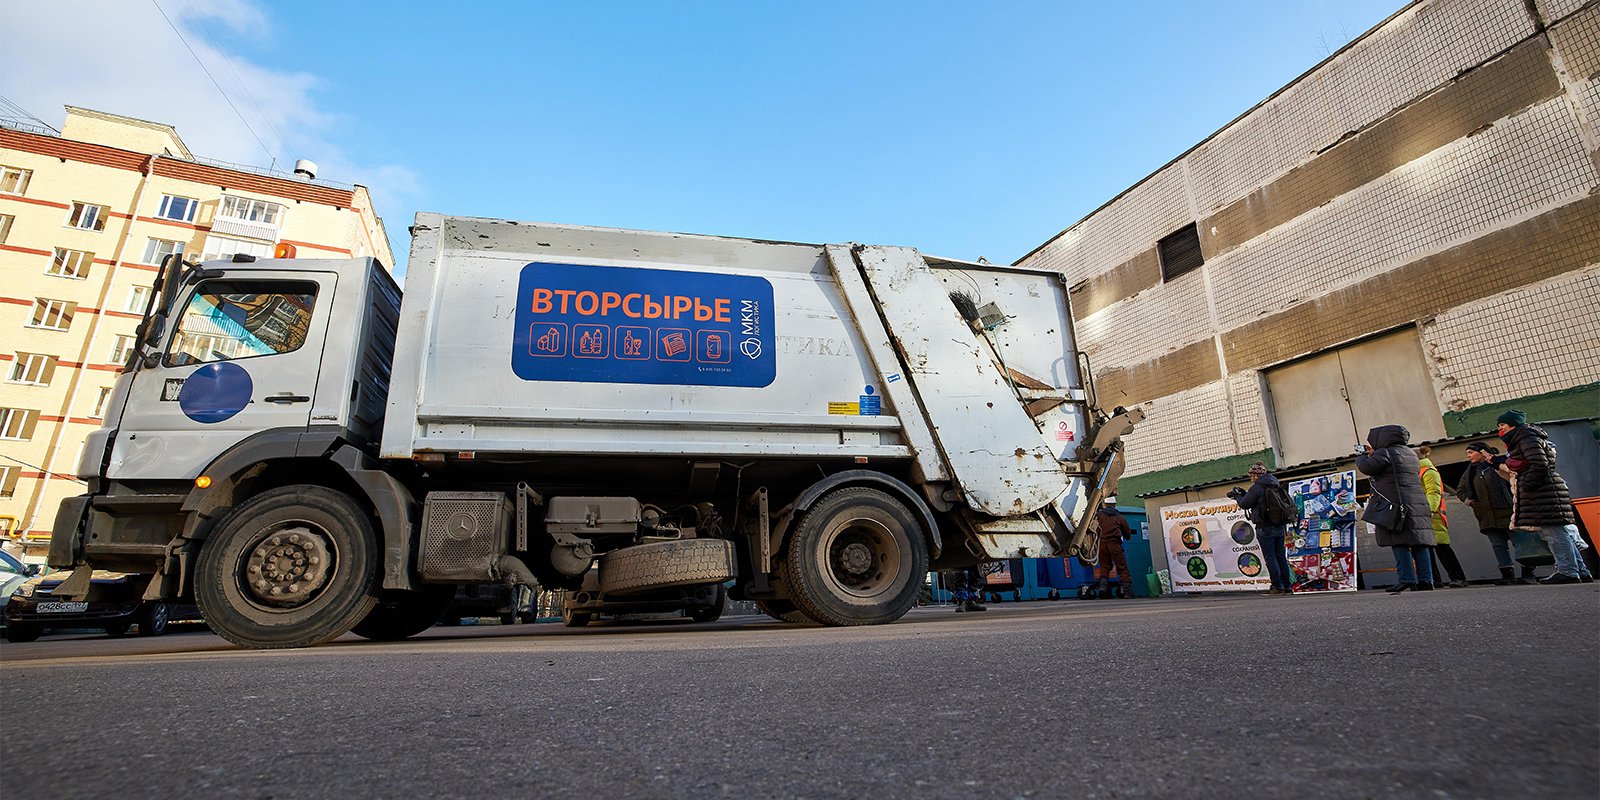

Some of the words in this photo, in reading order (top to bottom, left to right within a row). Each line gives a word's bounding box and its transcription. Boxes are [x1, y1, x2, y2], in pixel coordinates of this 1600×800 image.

[531, 288, 732, 323] ВТОРСЫРЬЕ
[740, 299, 754, 335] МКМ
[775, 335, 854, 357] ТИКА
[1164, 510, 1198, 520] Москва
[1179, 519, 1200, 527] СОБИРАЙ
[1232, 544, 1260, 553] СОХРАНЯЙ
